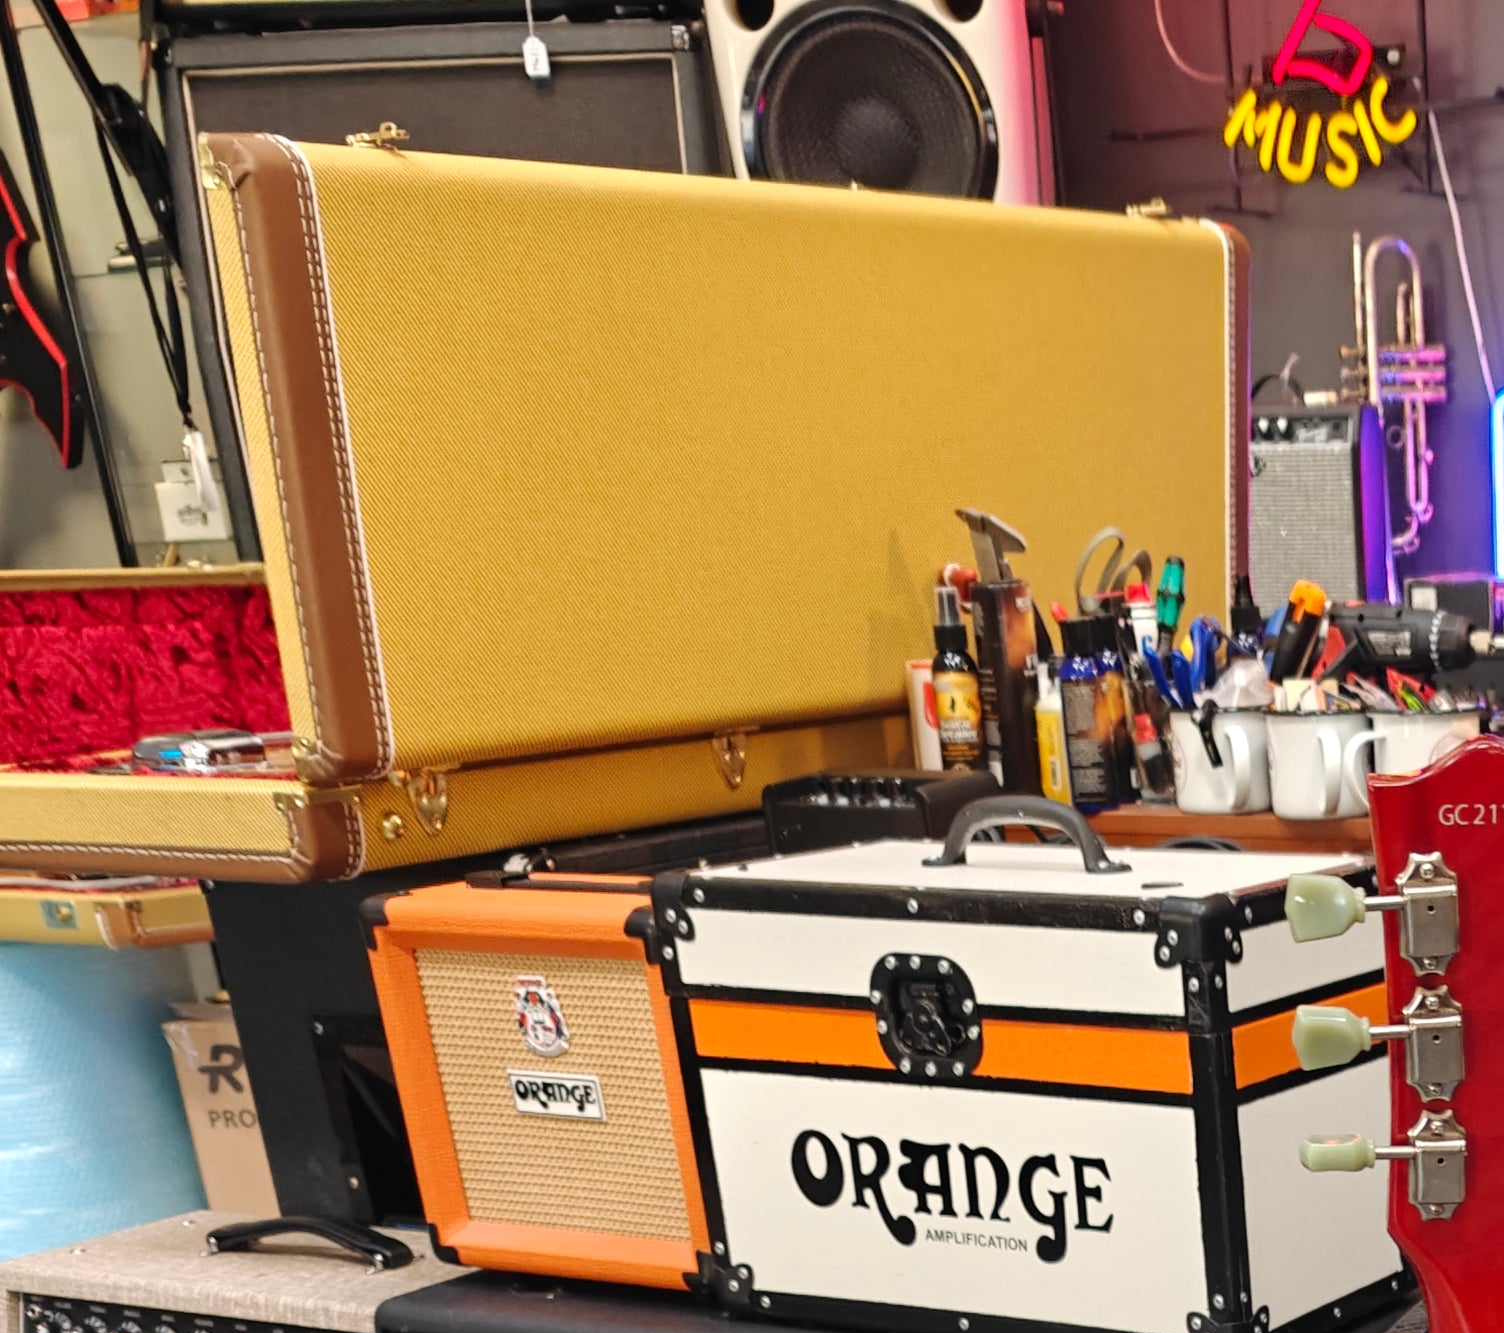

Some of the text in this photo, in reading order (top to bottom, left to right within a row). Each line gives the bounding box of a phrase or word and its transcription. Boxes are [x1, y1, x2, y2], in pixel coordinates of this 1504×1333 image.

[1223, 74, 1418, 190] MUSIC
[515, 1079, 597, 1113] ORANGE
[791, 1129, 1114, 1264] ORANGE
[925, 1228, 1028, 1253] AMPLIFICATION
